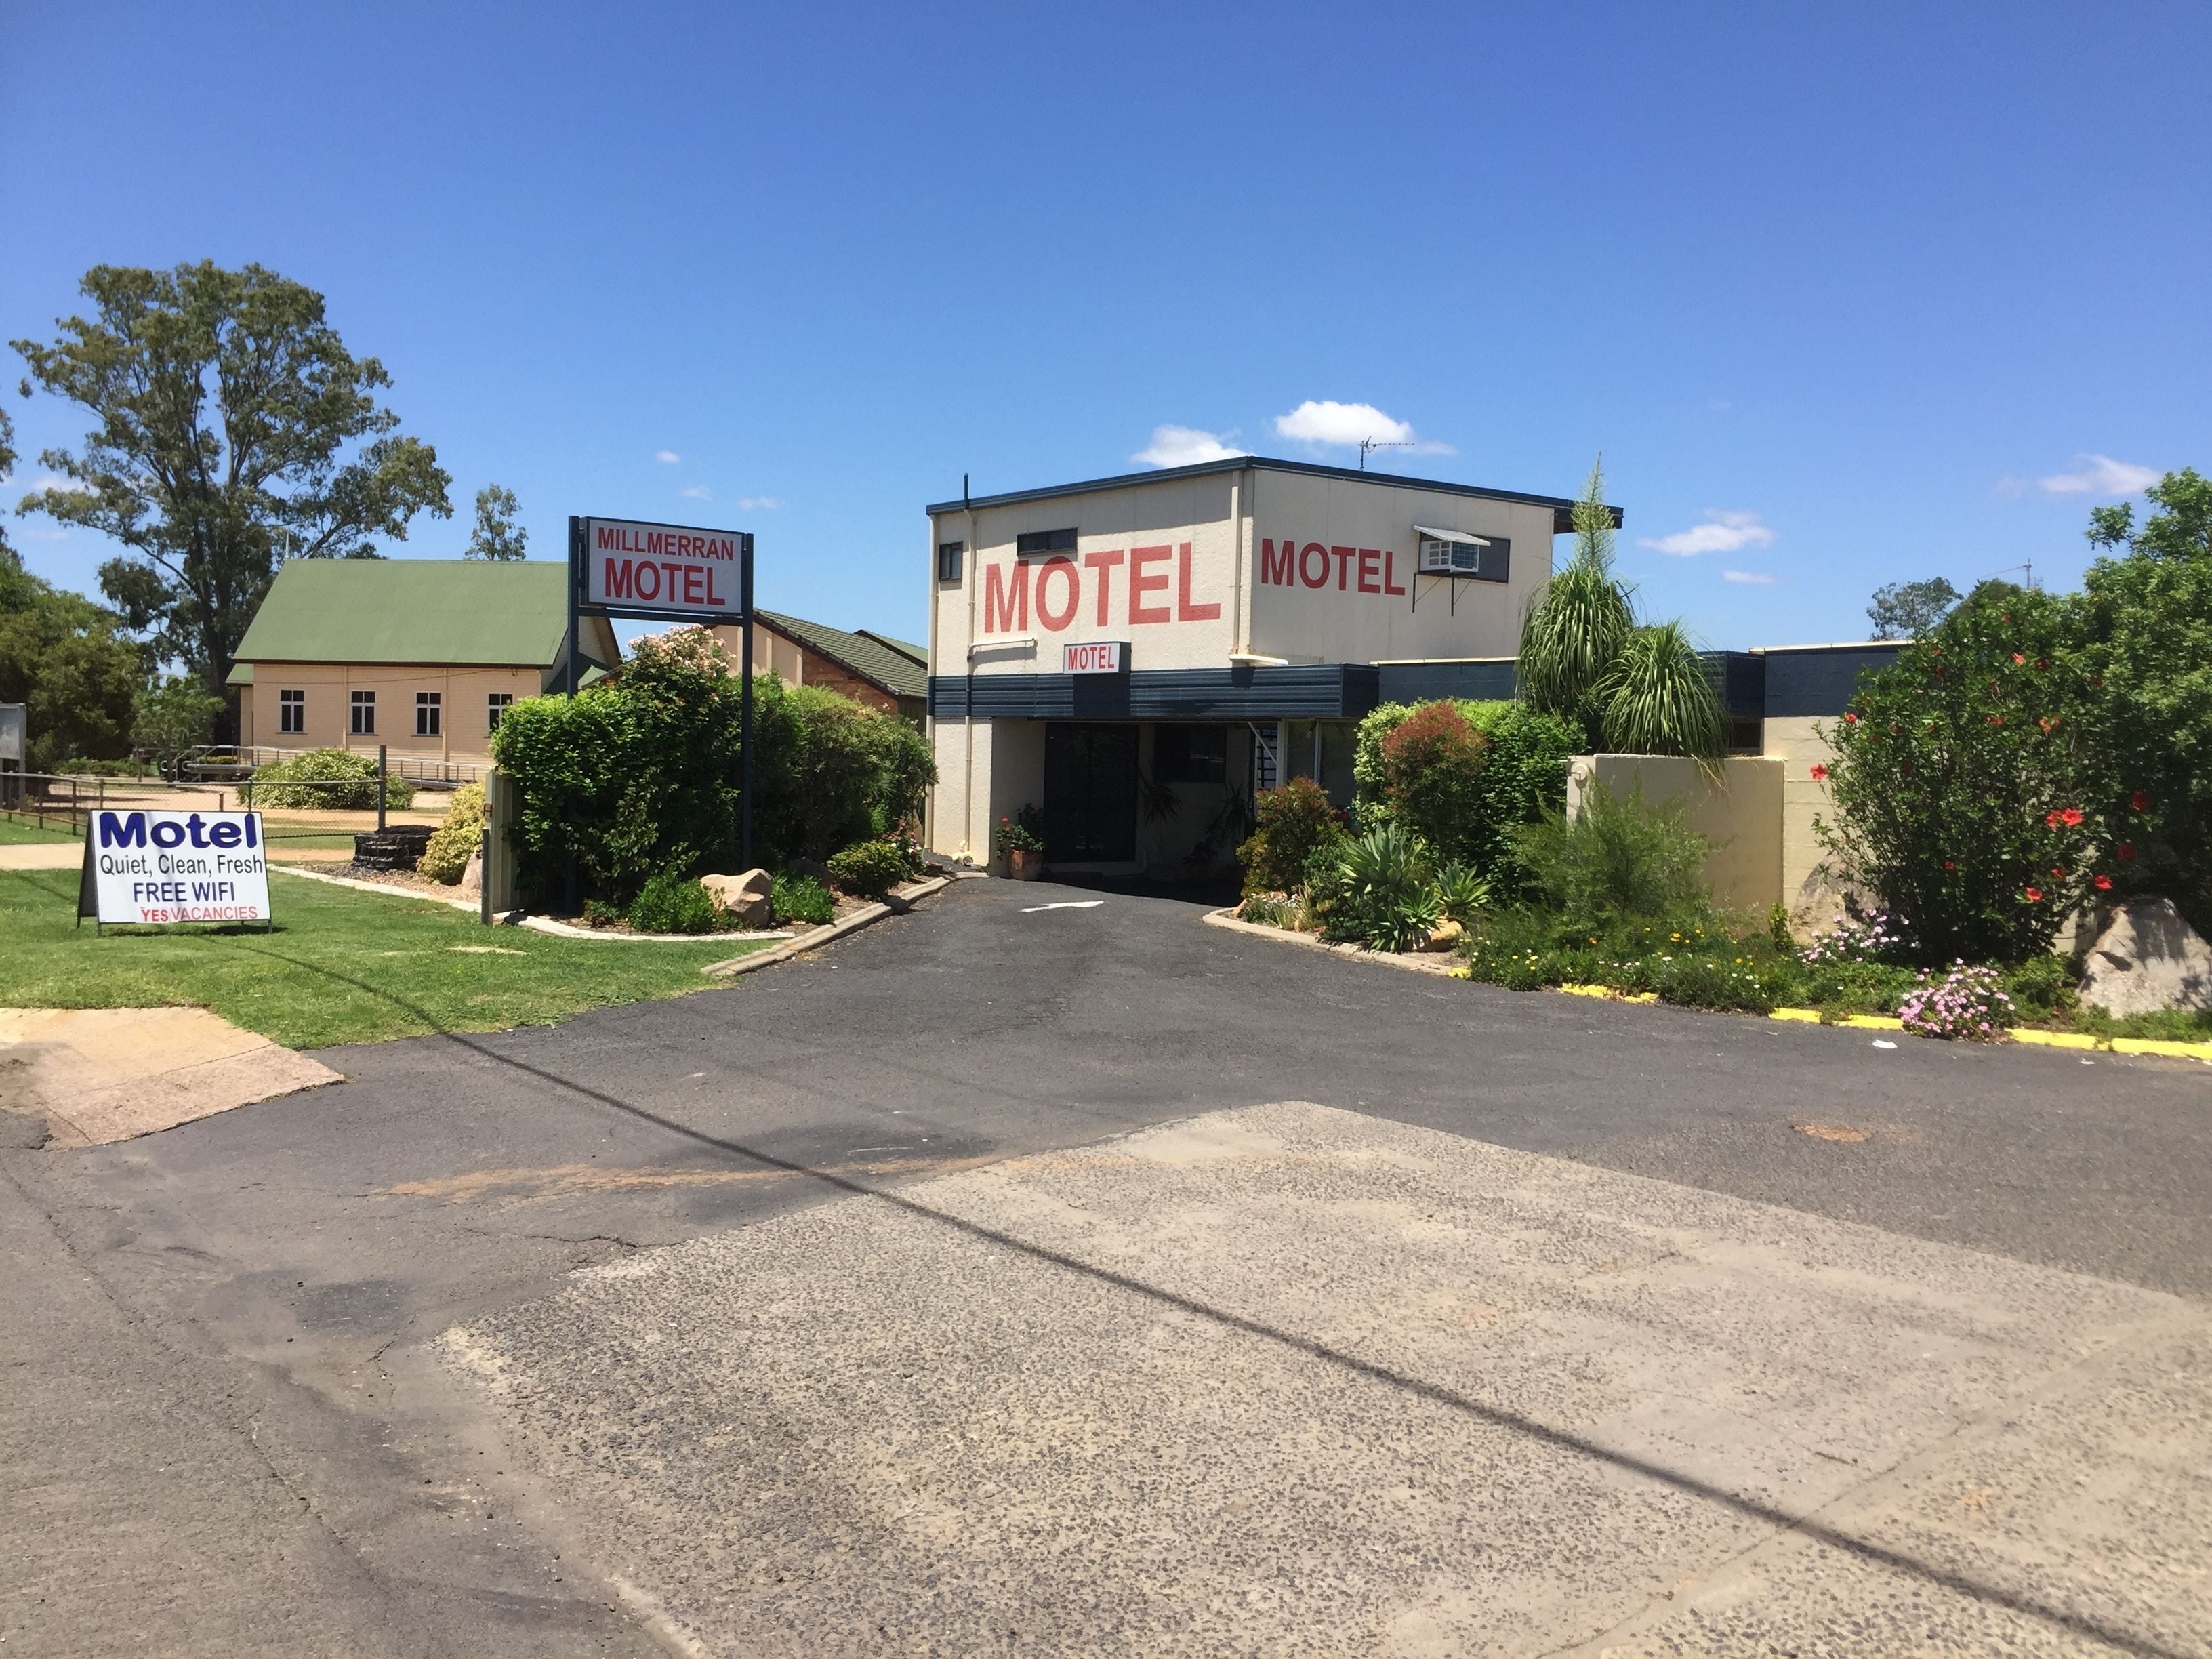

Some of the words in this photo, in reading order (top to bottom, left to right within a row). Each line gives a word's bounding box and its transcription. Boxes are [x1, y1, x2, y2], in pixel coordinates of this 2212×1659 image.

[598, 527, 734, 561] MILLMERRAN
[605, 558, 726, 605] MOTEL
[1261, 537, 1406, 596] MOTEL
[985, 542, 1221, 633] MOTEL
[1068, 646, 1115, 670] MOTEL
[100, 812, 257, 848] Motel
[100, 855, 153, 877] Quiet,
[158, 855, 212, 877] Clean,
[217, 855, 263, 874] Fresh
[133, 882, 187, 902] FREE
[192, 882, 235, 901] WIFI
[141, 909, 169, 922] YES
[170, 906, 258, 920] VACANCIES
